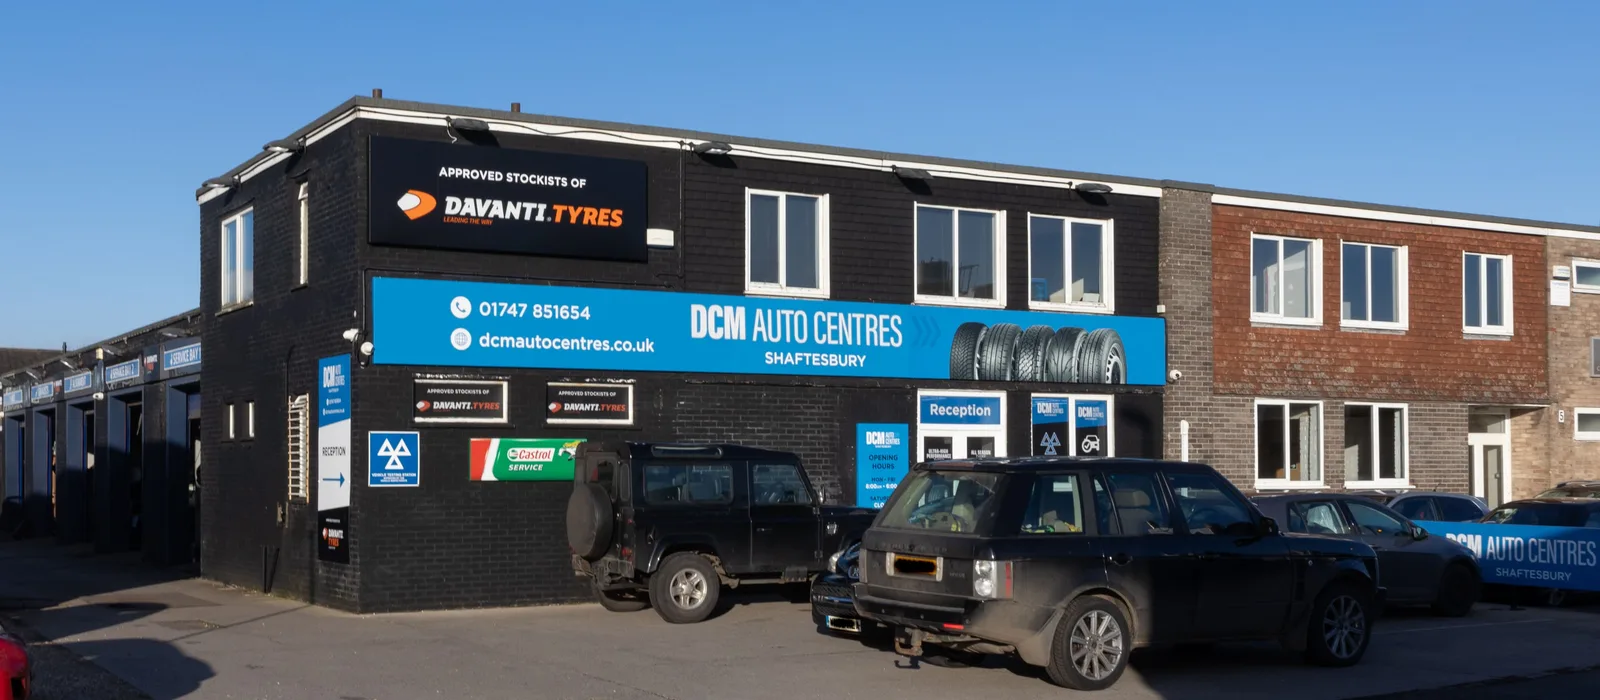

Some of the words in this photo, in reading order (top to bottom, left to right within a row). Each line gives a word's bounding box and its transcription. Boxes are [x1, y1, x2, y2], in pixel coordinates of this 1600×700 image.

[439, 166, 503, 182] APPROVED
[506, 172, 568, 187] STOCKISTS
[570, 178, 586, 188] OF
[444, 216, 468, 224] LEADING
[552, 204, 624, 228] TYRES
[479, 301, 528, 318] 01747
[532, 304, 591, 320] 851654
[690, 303, 746, 340] DCM
[752, 308, 808, 344] AUTO
[814, 311, 902, 348] CENTRES
[479, 332, 654, 354] dcmautocentres.co.uk
[764, 351, 866, 368] SHAFTESBURY
[930, 403, 991, 418] Reception
[1037, 402, 1052, 414] DCM
[1078, 406, 1092, 418] DCM
[1560, 411, 1564, 421] 5
[866, 431, 885, 445] DCM
[322, 446, 346, 456] RECEPTION
[519, 449, 551, 460] Castrol
[1486, 536, 1524, 562] AUTO
[1528, 538, 1597, 567] CENTRES
[1496, 568, 1572, 581] SHAFTESBURY
